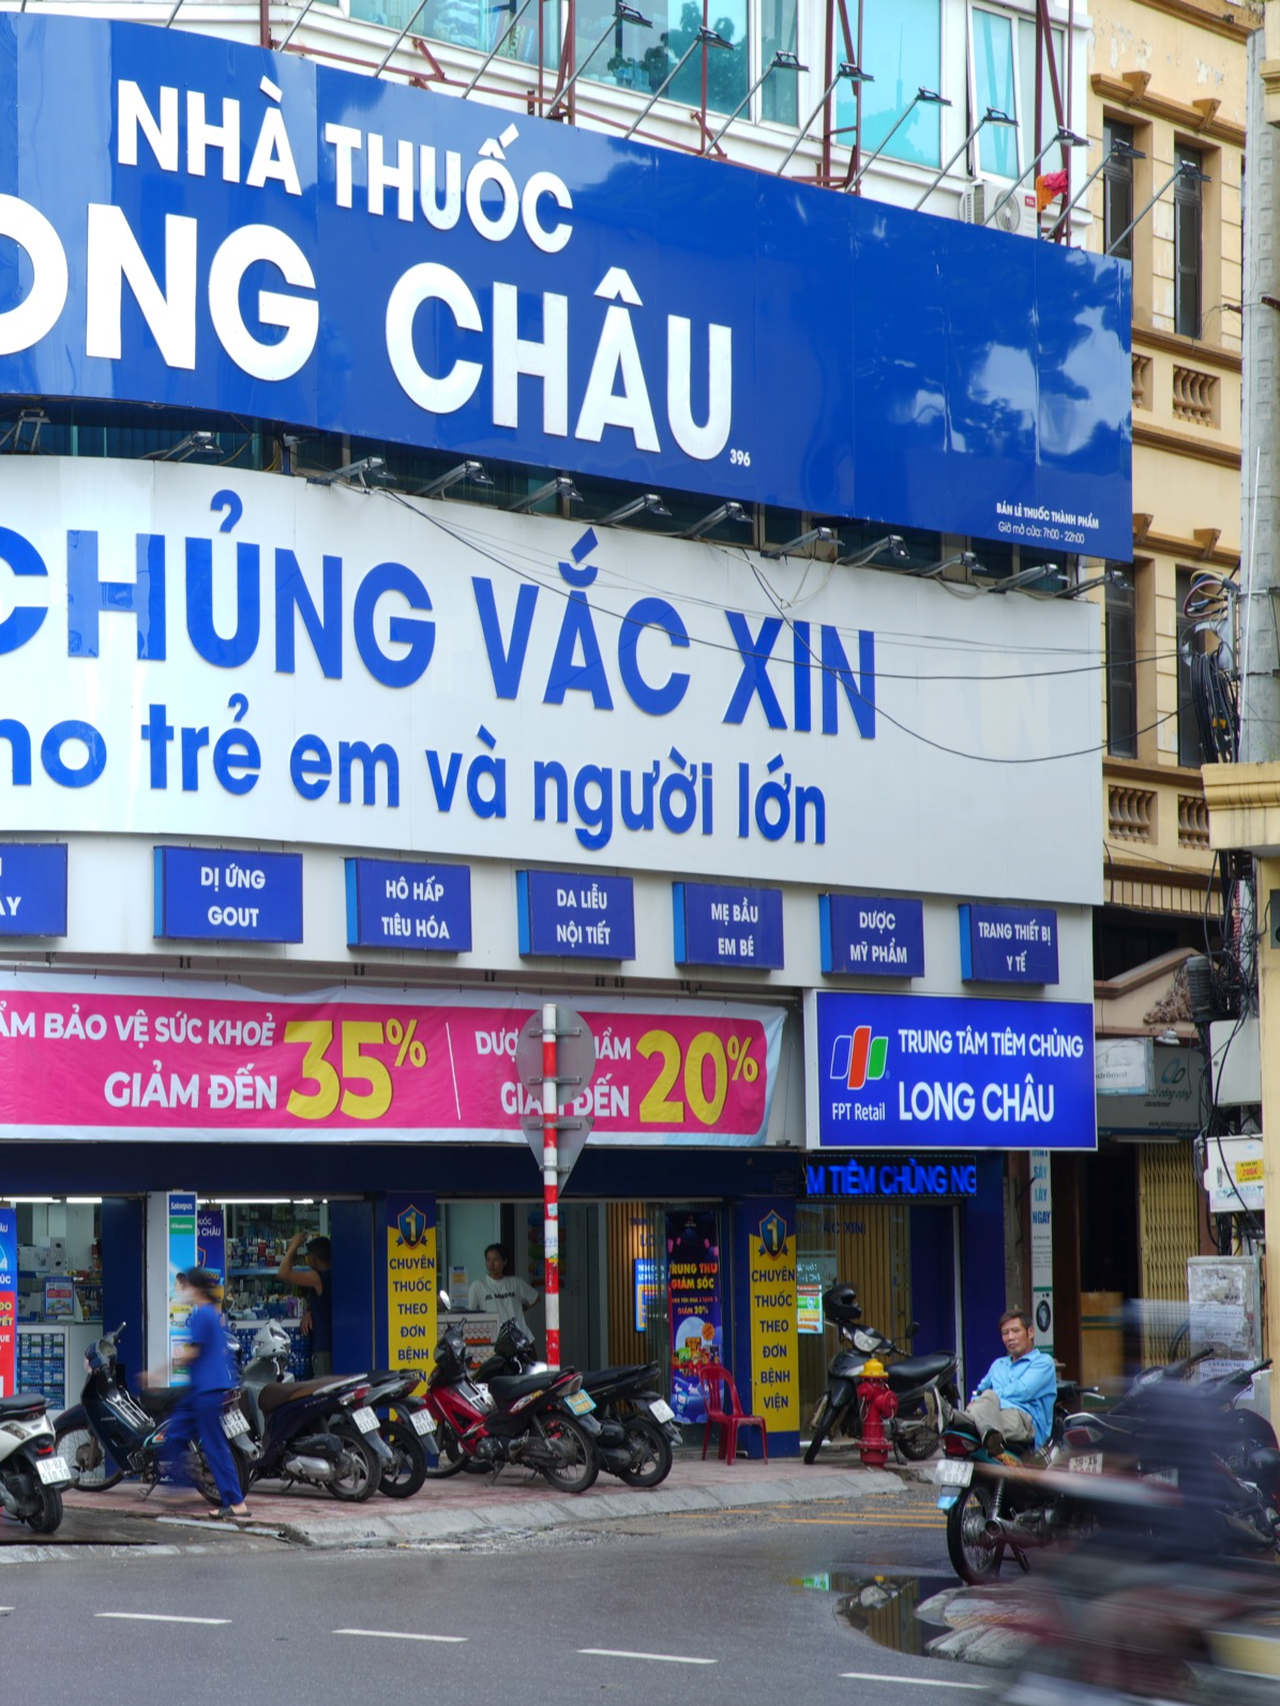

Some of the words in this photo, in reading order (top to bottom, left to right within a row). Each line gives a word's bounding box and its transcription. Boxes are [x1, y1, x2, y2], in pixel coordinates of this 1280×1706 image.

[118, 75, 302, 196] NHÀ
[325, 122, 573, 254] THUỐC
[386, 266, 733, 461] CHÂU
[730, 448, 752, 468] 396
[996, 500, 1013, 516] BÁN
[1014, 502, 1022, 517] LẺ
[1024, 505, 1050, 522] THUỐC
[1051, 510, 1076, 526] THÀNH
[1077, 512, 1099, 529] PHẨM
[998, 521, 1012, 534] Giờ
[1013, 523, 1025, 536] mở
[1043, 527, 1060, 540] 7h00
[1064, 531, 1085, 544] 22h00
[471, 526, 691, 716] VẮC
[722, 609, 876, 739] XIN
[141, 692, 261, 796] trẻ
[289, 733, 400, 808] em
[425, 723, 507, 819] và
[533, 745, 714, 851] người
[738, 752, 826, 846] lớn
[200, 866, 220, 894] DỊ
[224, 862, 266, 890] ỨNG
[385, 875, 409, 901] HÔ
[412, 875, 444, 903] HẤP
[556, 889, 577, 908] DA
[580, 883, 608, 910] LIỄU
[207, 905, 260, 929] GOUT
[711, 902, 730, 925] MẸ
[732, 897, 759, 924] BẦU
[859, 911, 896, 931] DƯỢC
[381, 911, 412, 938] TIÊU
[417, 913, 450, 940] HÓA
[556, 921, 582, 946] NỘI
[585, 917, 611, 945] TIẾT
[978, 921, 1013, 940] TRANG
[1014, 919, 1040, 942] THIẾT
[1042, 925, 1051, 946] BỊ
[718, 937, 738, 957] EM
[740, 934, 754, 957] BÉ
[850, 942, 870, 962] MỸ
[872, 936, 908, 965] PHẨM
[1006, 956, 1014, 972] Y
[1015, 950, 1027, 972] TẾ
[44, 1004, 107, 1041] BẢO
[113, 1009, 149, 1049] VỆ
[155, 1011, 203, 1045] SỨC
[208, 1012, 276, 1047] KHOẺ
[898, 1029, 953, 1054] TRUNG
[956, 1025, 988, 1055] TÂM
[991, 1026, 1026, 1057] TIÊM
[1028, 1027, 1084, 1059] CHỦNG
[283, 1017, 427, 1120] 35%
[635, 1027, 759, 1126] 20%
[104, 1060, 206, 1110] GIẢM
[208, 1063, 278, 1110] ĐẾN
[899, 1080, 976, 1122] LONG
[981, 1073, 1055, 1123] CHÂU
[832, 1102, 852, 1121] FPT
[854, 1102, 886, 1121] Retail
[828, 1158, 876, 1195] TIÊM
[878, 1157, 948, 1195] CHỦNG
[950, 1165, 977, 1194] NG
[170, 1202, 193, 1211] Salonpas
[1032, 1211, 1051, 1224] NGAY
[751, 1265, 796, 1282] CHUYÊN
[754, 1289, 793, 1307] THUỐC
[759, 1319, 789, 1333] THEO
[762, 1343, 787, 1358] ĐƠN
[760, 1368, 791, 1387] BỆNH
[763, 1392, 789, 1412] VIỆN
